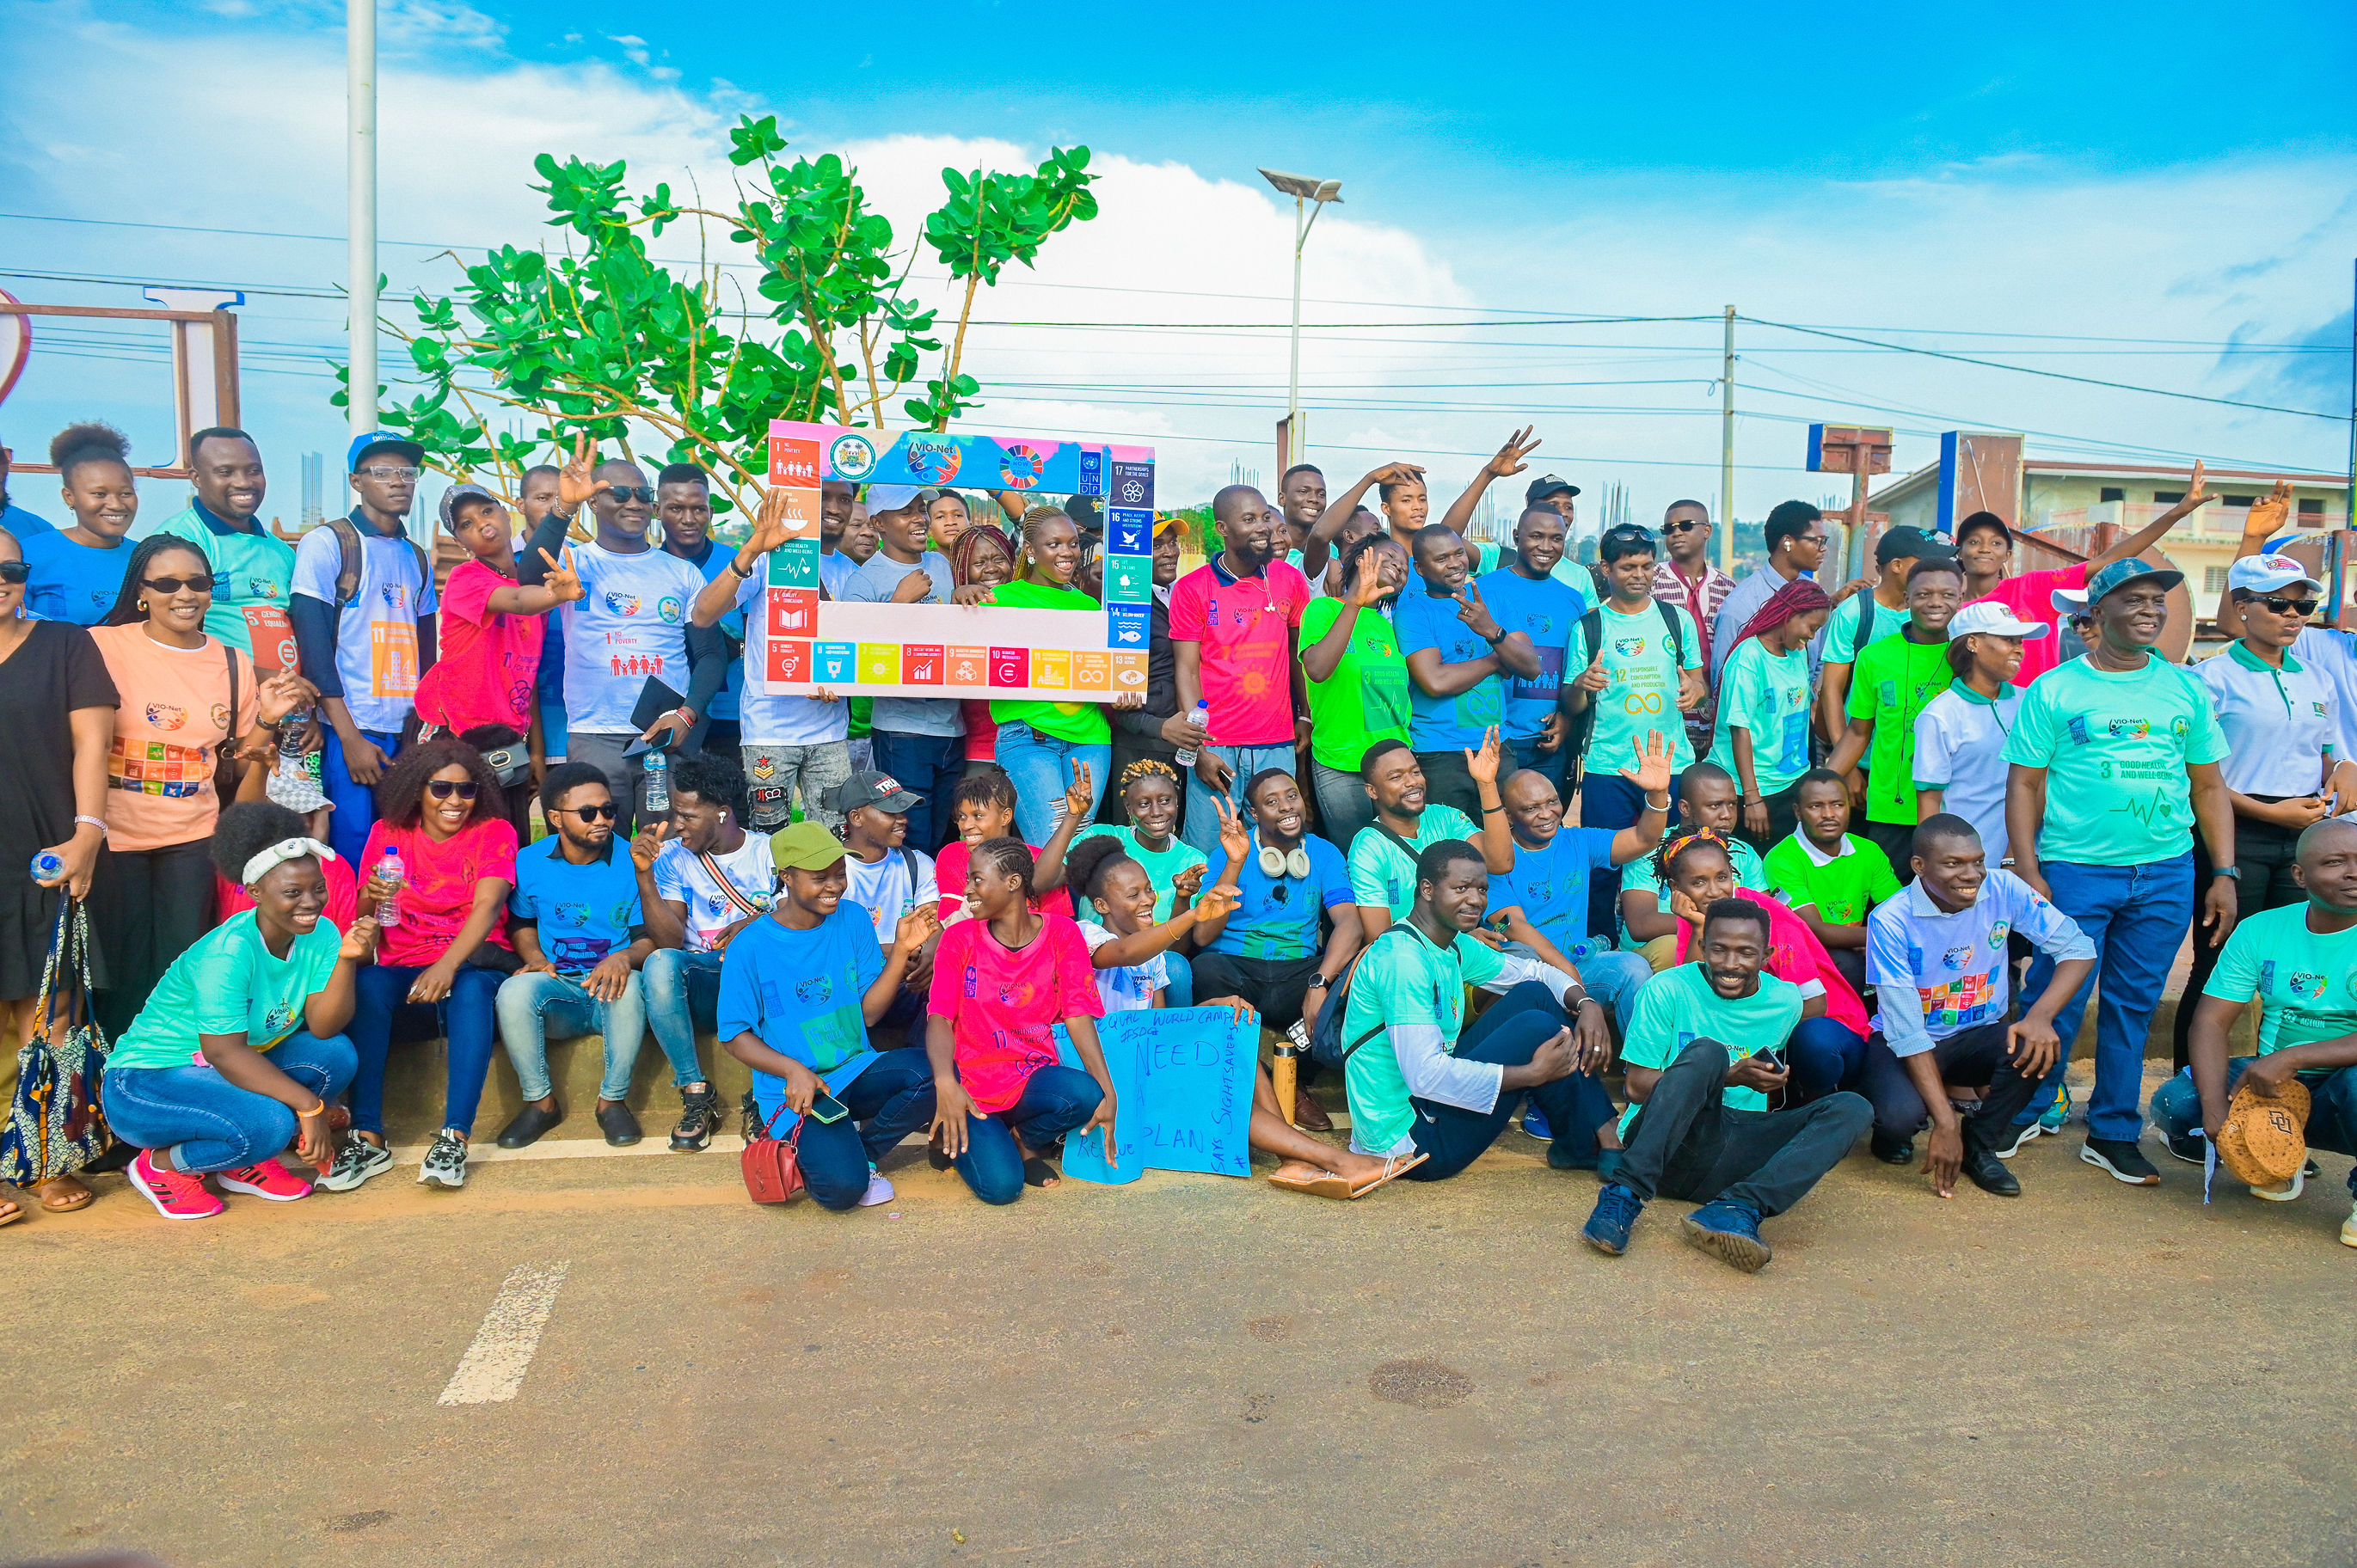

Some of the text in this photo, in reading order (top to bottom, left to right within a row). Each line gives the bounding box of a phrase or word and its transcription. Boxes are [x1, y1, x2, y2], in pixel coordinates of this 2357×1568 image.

[776, 442, 780, 452] 1
[916, 443, 954, 454] VIO-Net
[1115, 465, 1123, 476] 17
[1112, 512, 1120, 522] 16
[1111, 560, 1120, 570] 15
[611, 591, 636, 601] VIO-Net
[244, 610, 260, 627] 5
[372, 627, 385, 643] 11
[605, 632, 611, 645] 1
[772, 643, 777, 653] 5
[906, 647, 911, 657] 8
[949, 648, 954, 658] 9
[991, 650, 1001, 659] 10
[1115, 655, 1123, 665] 13
[1615, 669, 1627, 683] 12
[152, 703, 182, 713] VIO-Net
[2100, 761, 2111, 779] 3
[2120, 760, 2166, 770] GOOD HEALTH
[2121, 770, 2173, 781] AND WELL-BEING
[1947, 945, 1971, 953] VIO-Net
[800, 976, 826, 988] VIO-Net
[2297, 972, 2326, 981] VIO-Ne
[1096, 1012, 1140, 1033] EQUAL
[1153, 1009, 1194, 1026] WORLD
[2299, 1017, 2326, 1029] ACTION
[992, 1030, 1008, 1049] 17
[1134, 1037, 1220, 1085] NEED
[1211, 1136, 1226, 1175] SAYS
